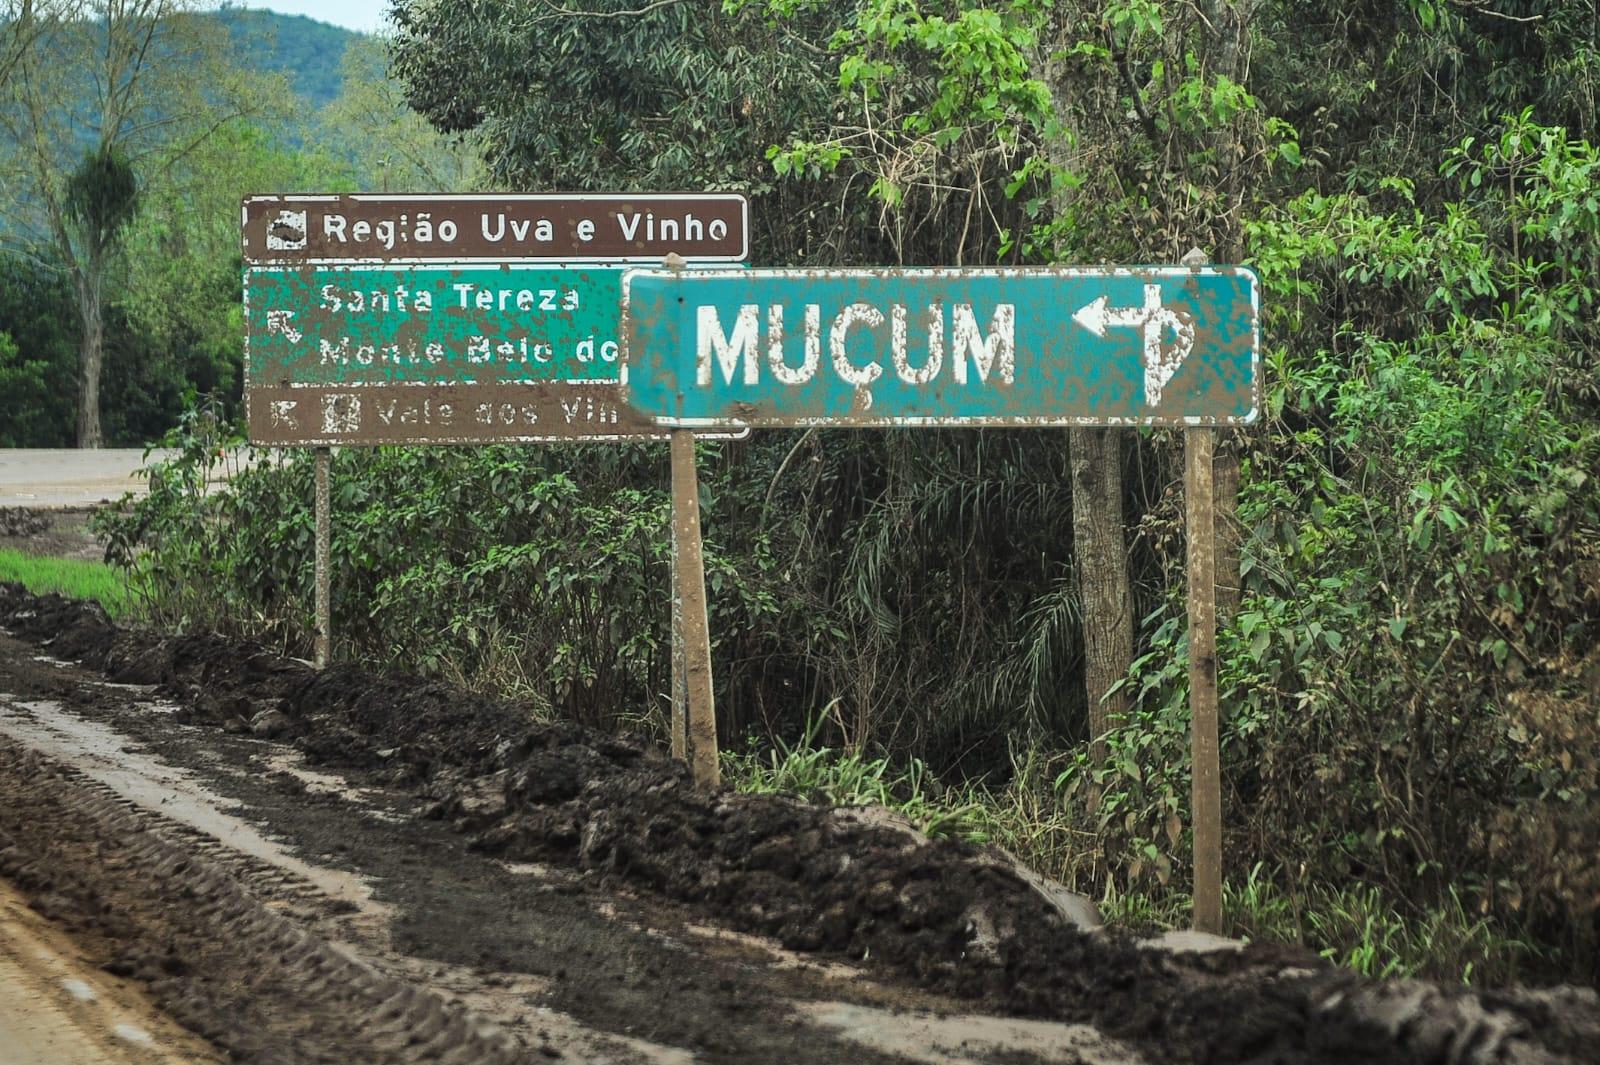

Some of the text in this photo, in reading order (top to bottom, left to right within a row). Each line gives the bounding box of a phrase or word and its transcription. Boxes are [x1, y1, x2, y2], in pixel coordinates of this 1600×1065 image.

[323, 212, 728, 250] Região Uva e Vinho
[320, 283, 580, 312] Santa Tereza
[696, 303, 1016, 411] MUÇUM
